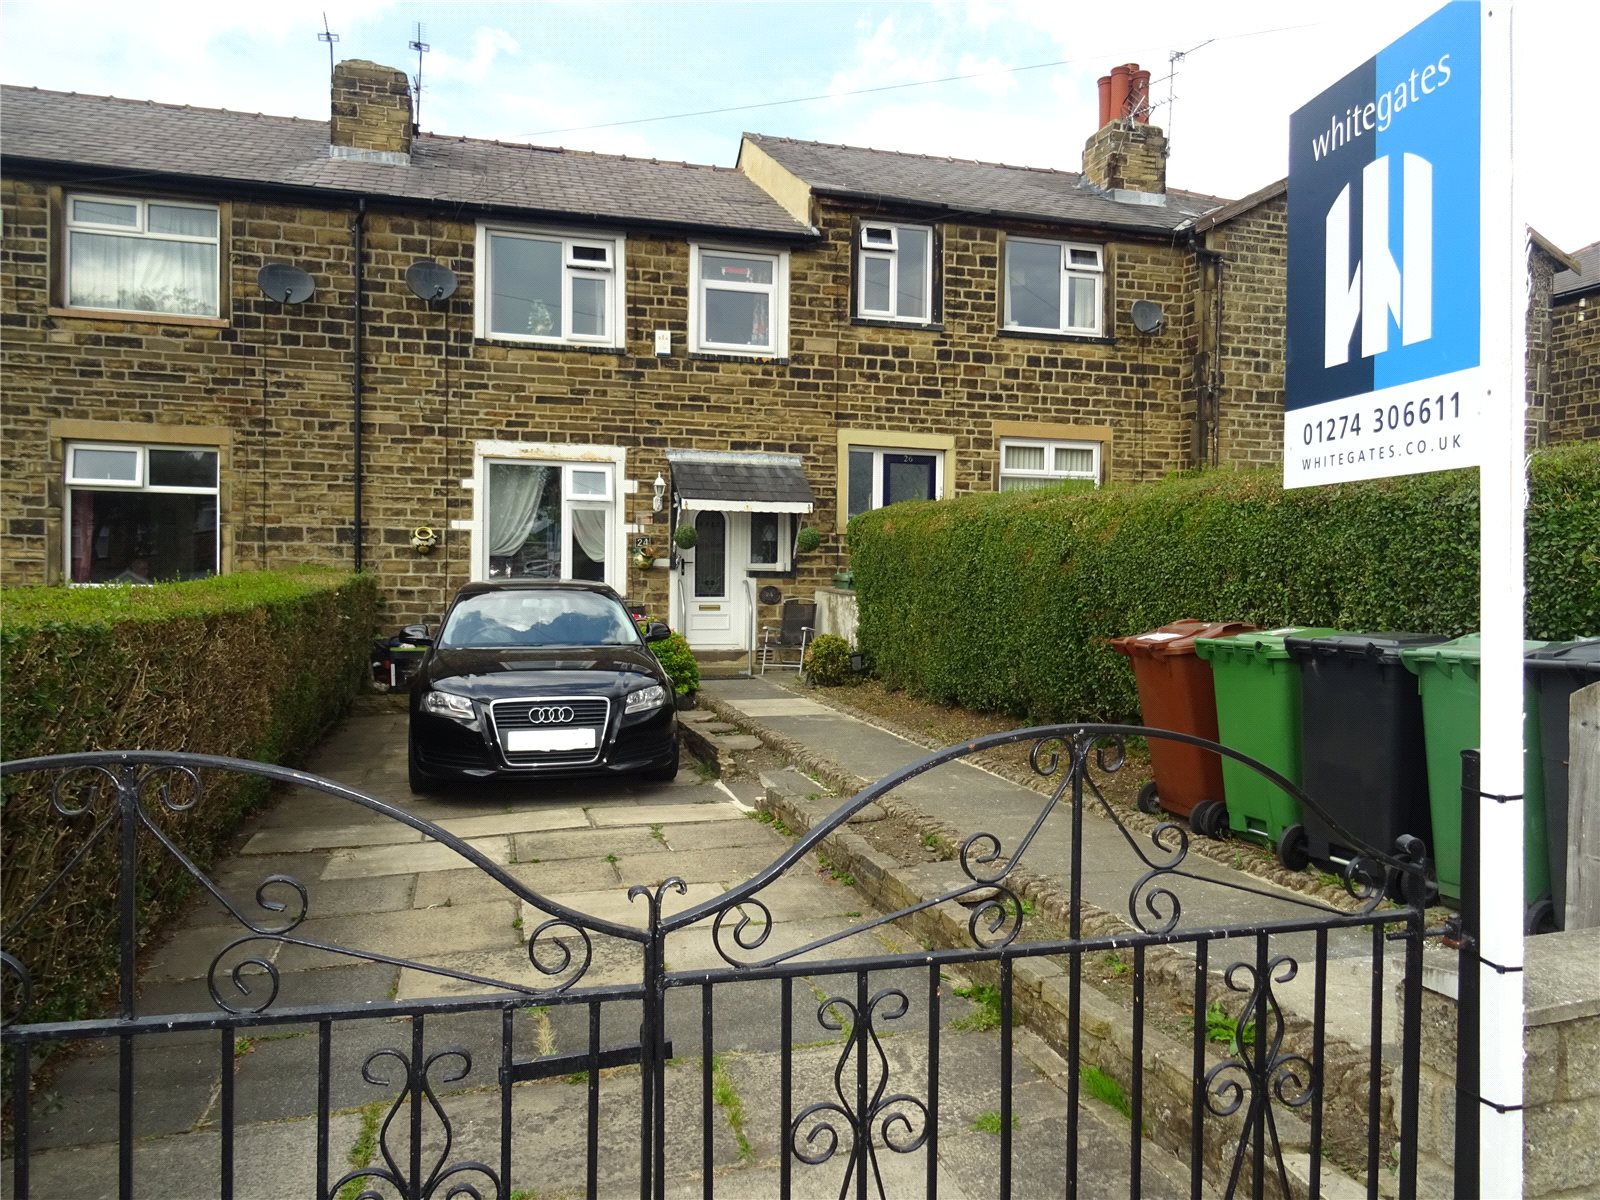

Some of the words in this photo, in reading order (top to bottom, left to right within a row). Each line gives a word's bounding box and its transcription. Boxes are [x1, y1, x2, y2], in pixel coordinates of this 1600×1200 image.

[1312, 53, 1451, 162] whitegates
[1303, 413, 1361, 446] 01274
[1373, 391, 1460, 434] 306611
[903, 455, 914, 463] 26
[1302, 434, 1462, 471] WHITEGATES.CO.UK
[637, 538, 649, 547] 24
